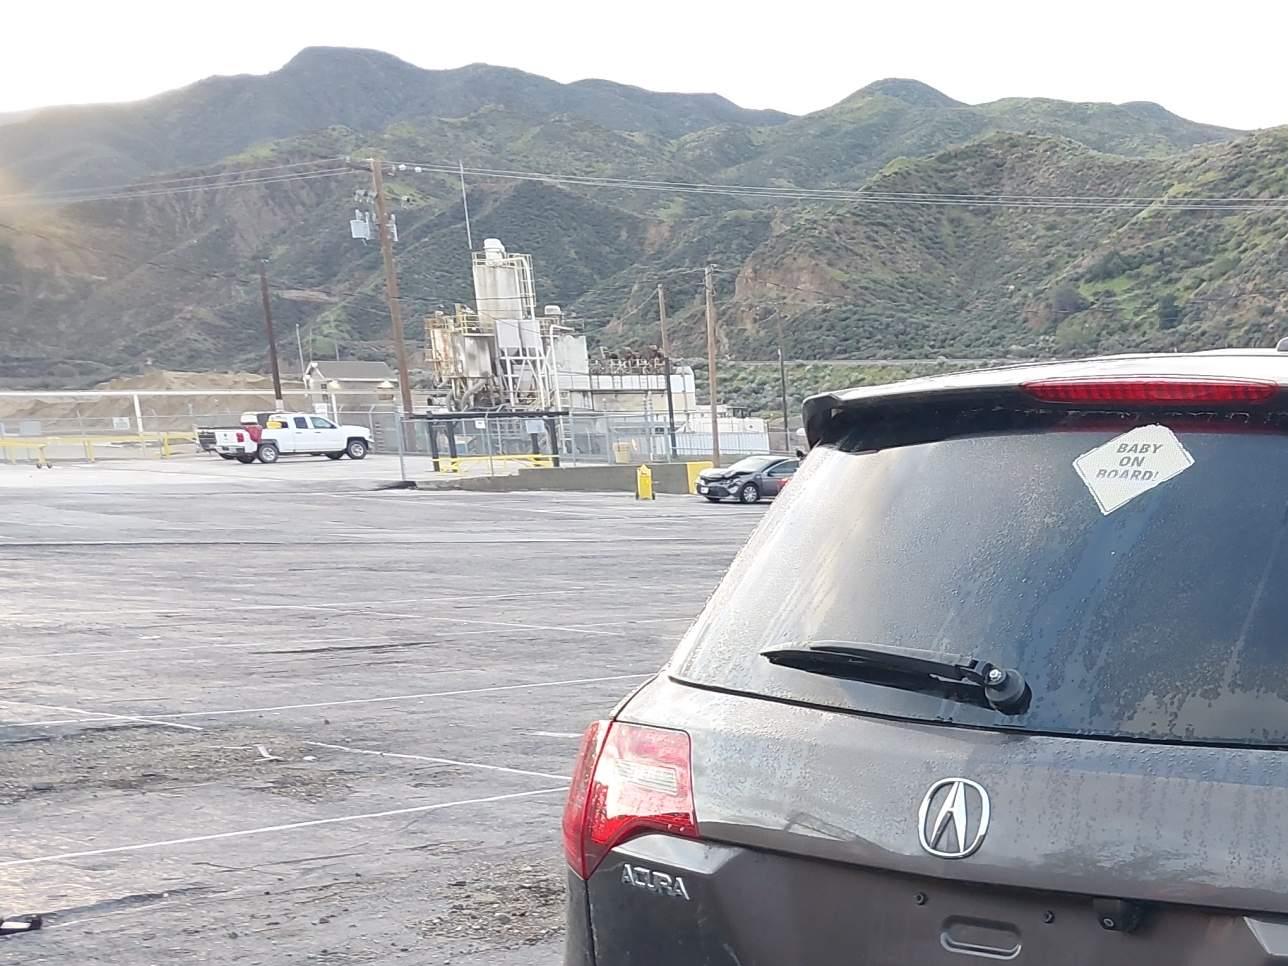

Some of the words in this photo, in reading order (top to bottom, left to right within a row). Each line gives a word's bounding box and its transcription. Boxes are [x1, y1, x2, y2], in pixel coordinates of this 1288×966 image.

[1116, 443, 1163, 454] BABY
[1119, 456, 1145, 467] ON
[1096, 469, 1159, 481] BOARD!
[621, 863, 690, 900] ACURA
